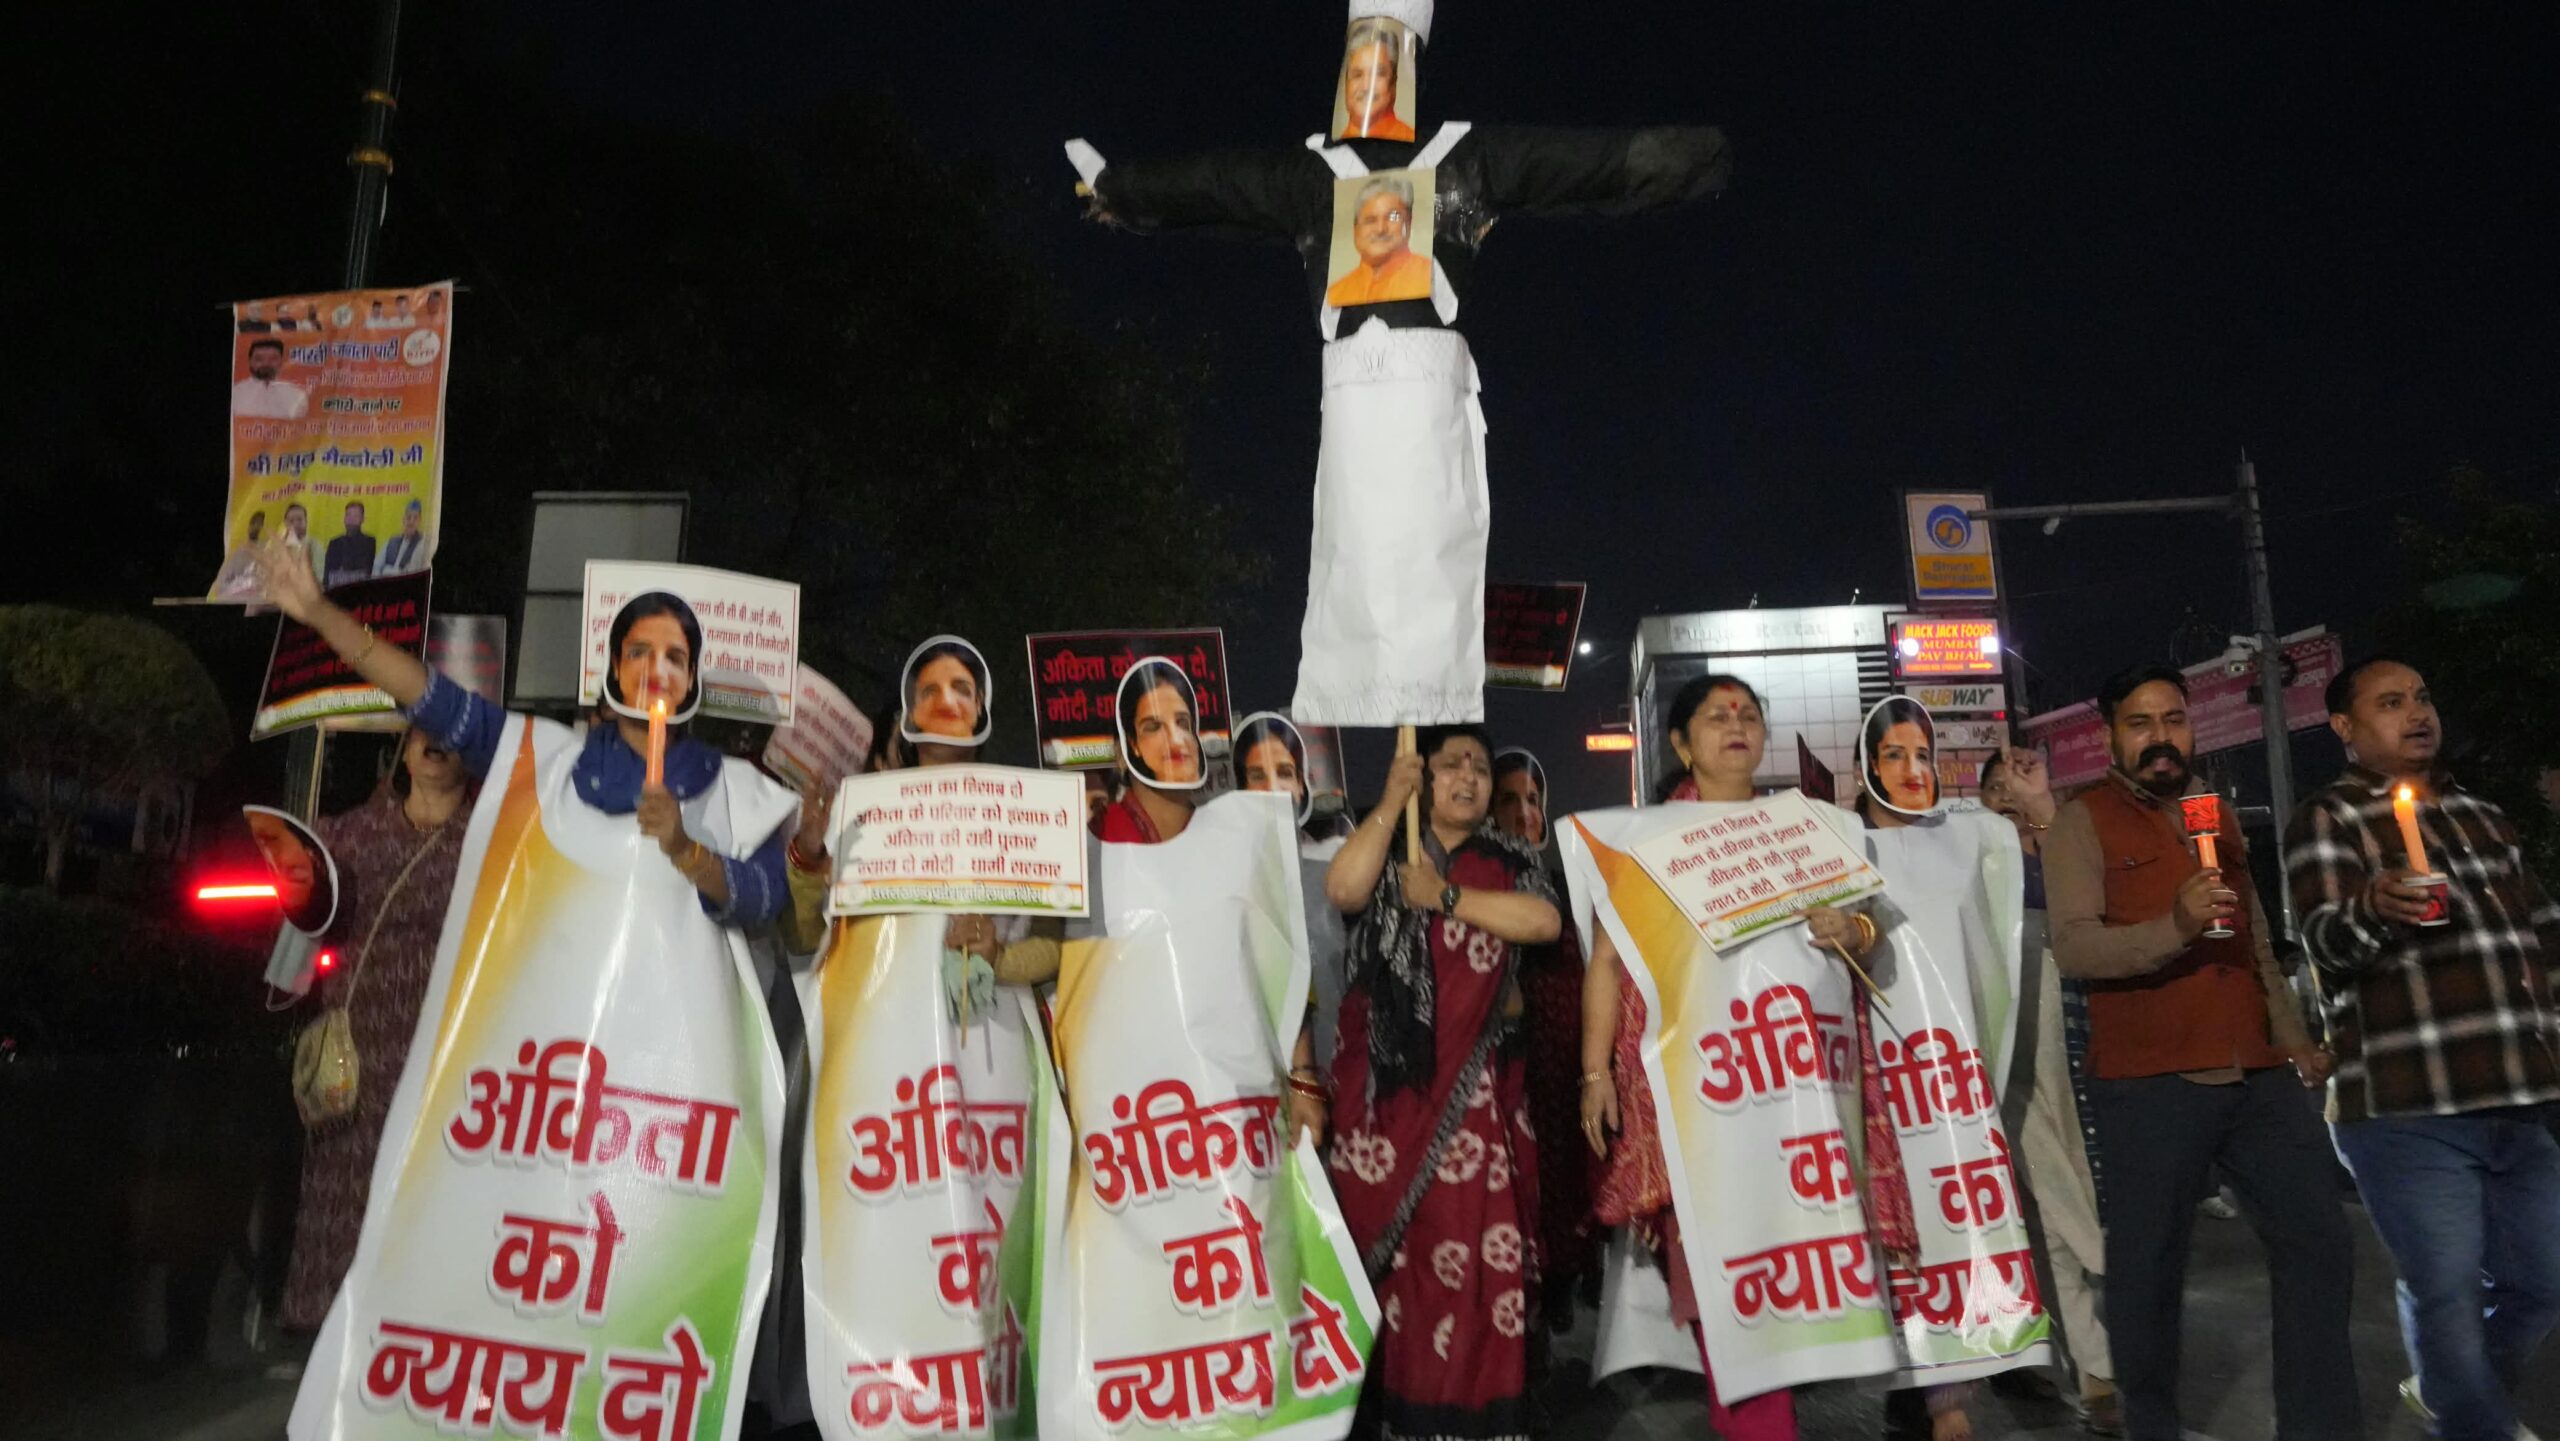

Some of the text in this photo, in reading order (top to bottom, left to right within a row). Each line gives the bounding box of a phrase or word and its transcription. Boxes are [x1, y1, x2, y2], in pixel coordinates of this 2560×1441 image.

[1936, 624, 1959, 637] JACK
[1961, 623, 1993, 637] FOODS
[1042, 649, 1106, 685] अंकिता
[1917, 651, 1942, 662] PAV
[1919, 688, 1988, 707] SUBWAY
[900, 776, 1023, 798] हत्या का हिसाब दो
[930, 803, 976, 821] परिवार
[982, 804, 1001, 822] को
[1055, 808, 1067, 827] दो
[1681, 810, 1773, 846] हत्या का हिसाब दो
[940, 829, 960, 848] की
[998, 832, 1037, 852] पुकार
[1667, 853, 1707, 877] अंकिता
[1706, 847, 1721, 862] के
[1720, 836, 1756, 857] परिवार
[1756, 831, 1773, 847] को
[1806, 819, 1819, 833] दो
[902, 854, 915, 873] दो
[921, 854, 954, 875] मोदी
[971, 857, 1005, 876] धामी
[1011, 860, 1062, 878] सरकार
[1703, 858, 1846, 914] न्याय दो मोदी धामी सरकार
[1707, 864, 1746, 888] अंकिता
[1746, 857, 1765, 873] की
[1783, 844, 1813, 867] पुकार
[450, 1039, 741, 1186] अंकिता
[1083, 1079, 1282, 1204] अंकिता
[1931, 1128, 2023, 1227] को
[493, 1190, 626, 1315] को
[1164, 1195, 1271, 1307] को
[1094, 1285, 1363, 1424] न्याय दो
[367, 1320, 709, 1441] न्याय दो
